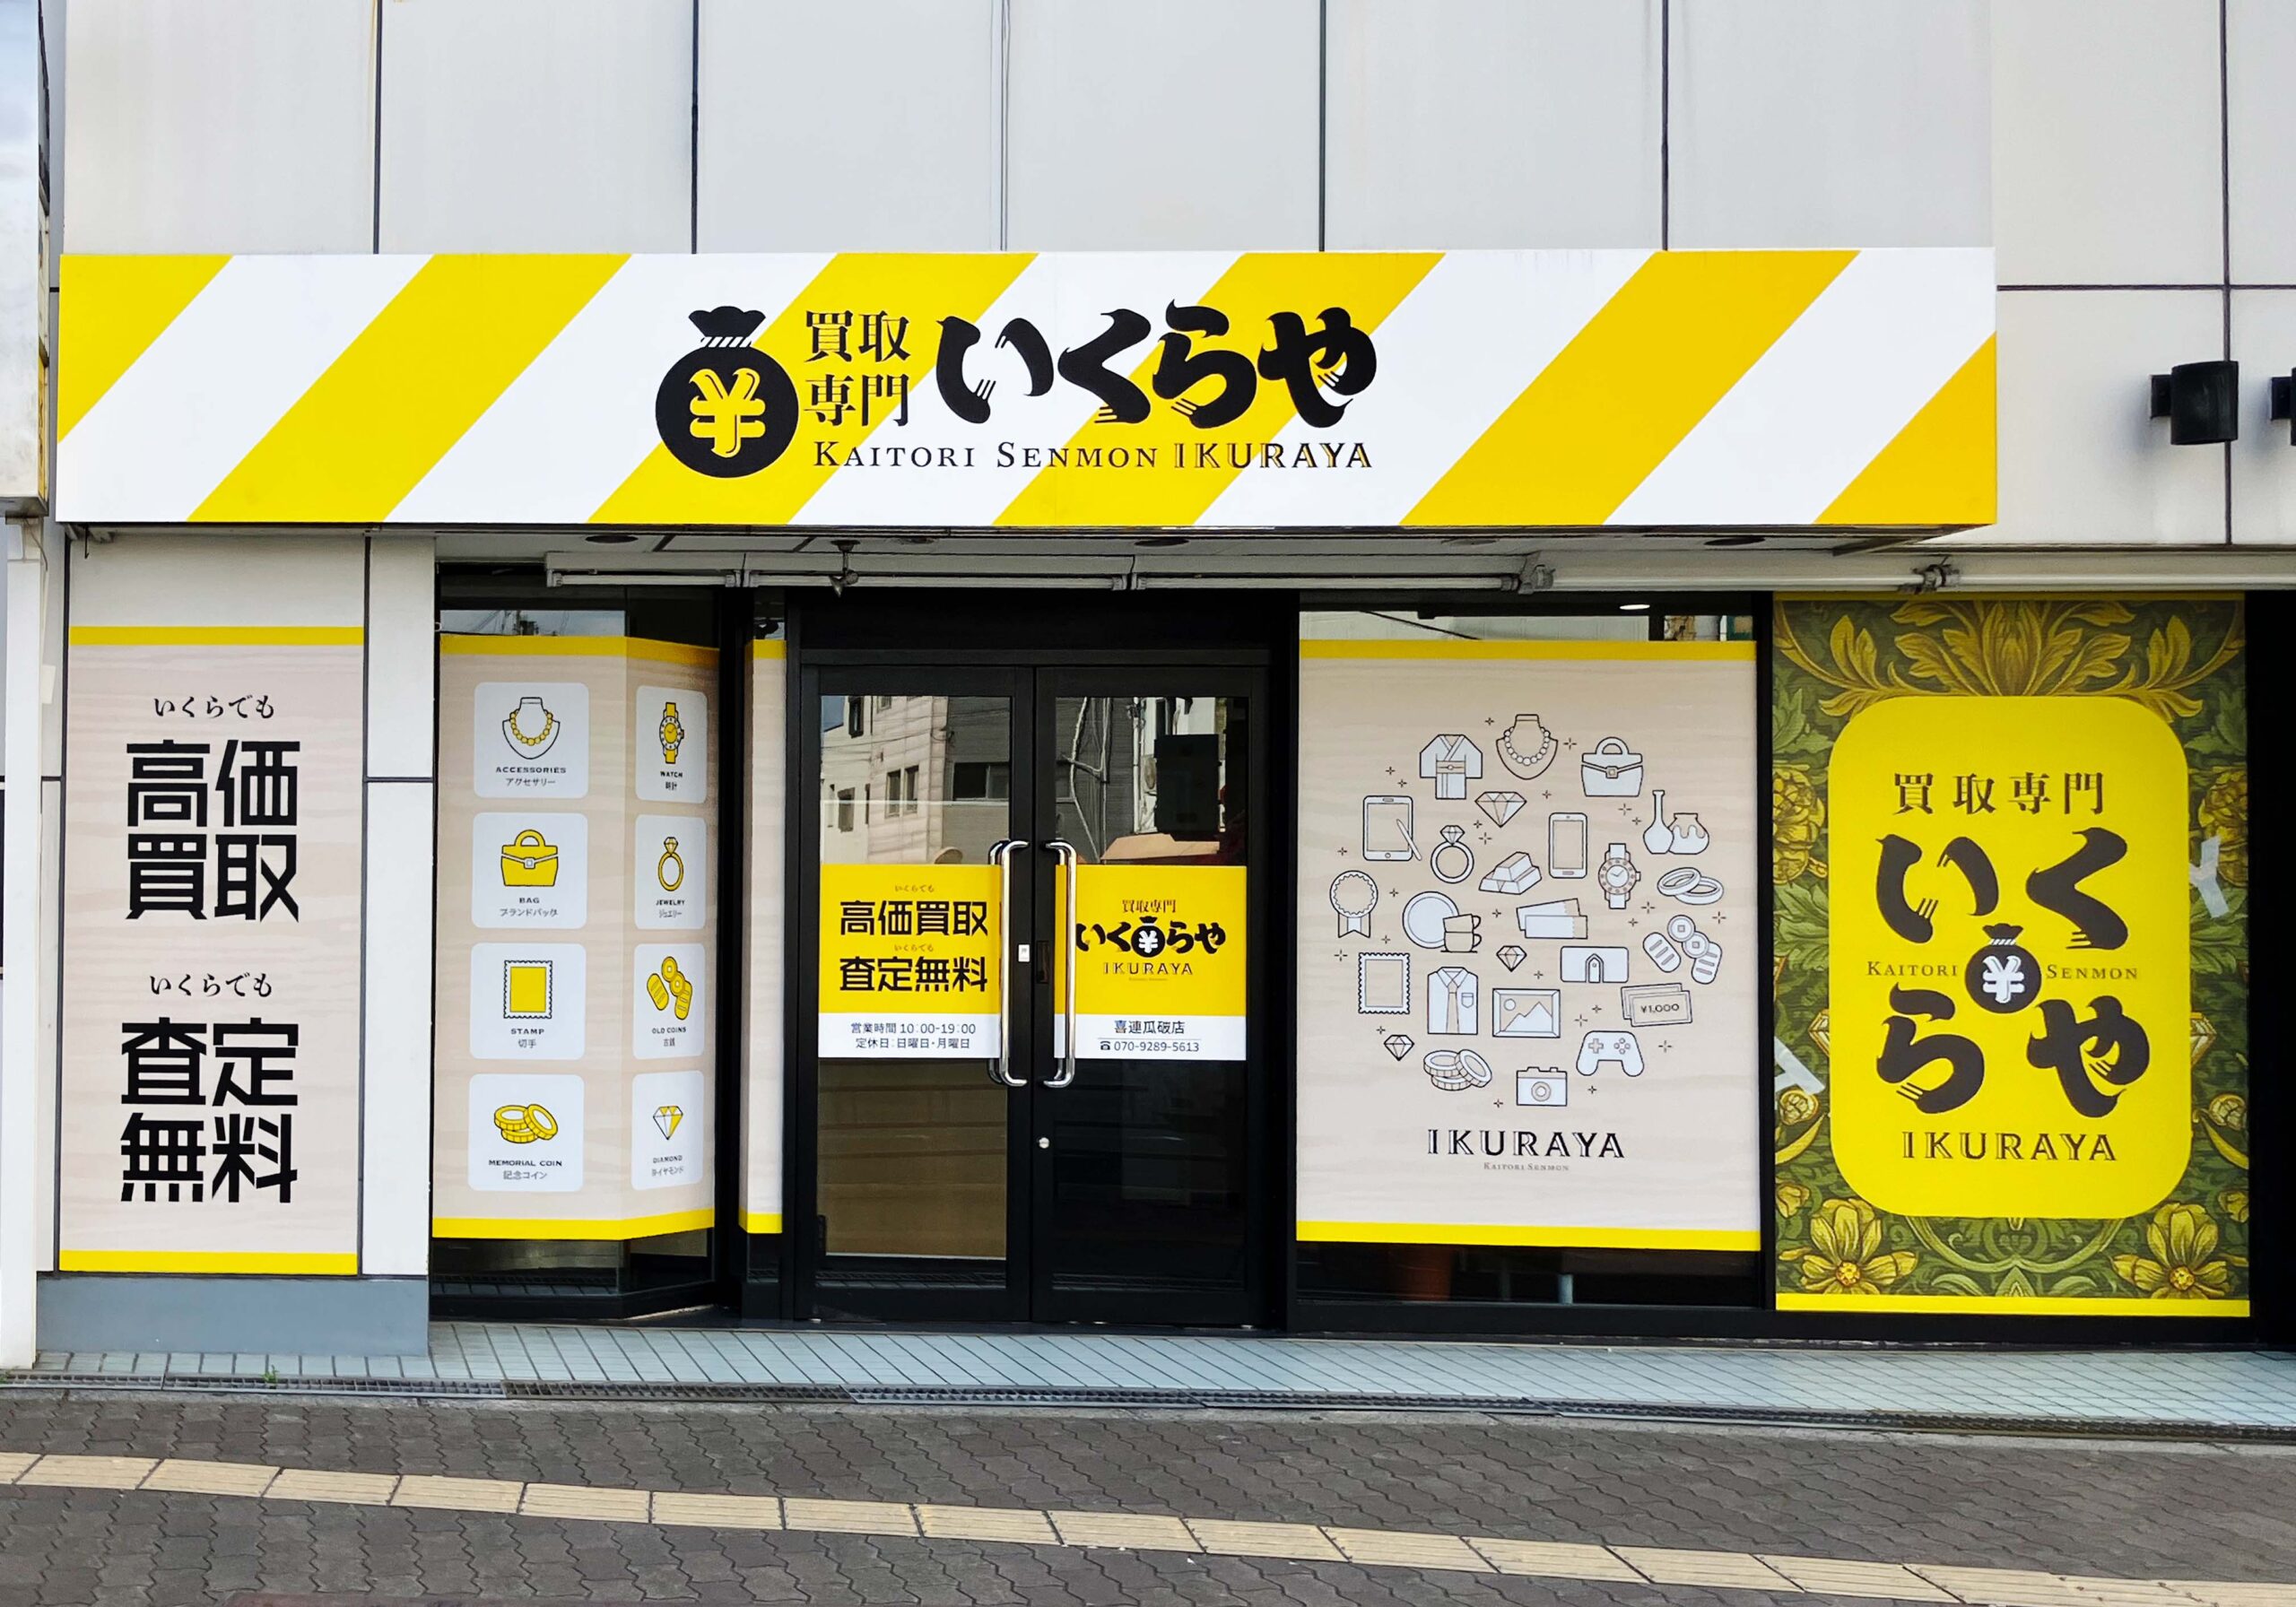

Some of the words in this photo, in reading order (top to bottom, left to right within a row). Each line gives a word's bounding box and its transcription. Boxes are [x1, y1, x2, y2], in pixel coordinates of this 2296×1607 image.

[805, 309, 911, 363] 買取
[935, 299, 1378, 429] いくらや
[804, 373, 910, 427] 専門
[1173, 442, 1373, 469] IKURAYA
[153, 694, 274, 719] いくらでも
[496, 766, 567, 774] ACCESSORIES
[506, 777, 556, 787] アクセサリー
[660, 770, 683, 778] WATCH
[126, 739, 300, 828] 高価
[1893, 771, 2105, 816] 買取専門
[125, 833, 300, 923] 買取
[839, 899, 988, 937] 高価買取
[1122, 899, 1177, 914] 買取専門
[839, 955, 988, 993] 査定無料
[1105, 962, 1194, 976] IKURAYA
[150, 972, 273, 998] いくらでも
[651, 1027, 665, 1035] OLD
[666, 1026, 687, 1034] COINS
[850, 1022, 897, 1034] 営業時間
[1114, 1020, 1186, 1035] 喜連瓜破店
[517, 1038, 536, 1049] 切手
[1114, 1041, 1200, 1053] 070-9289-5613
[121, 1016, 300, 1108] 査定
[1428, 1129, 1625, 1159] IKURAYA
[1902, 1131, 2118, 1162] IKURAYA
[119, 1112, 299, 1204] 無料
[503, 1169, 548, 1181] 記念コイン
